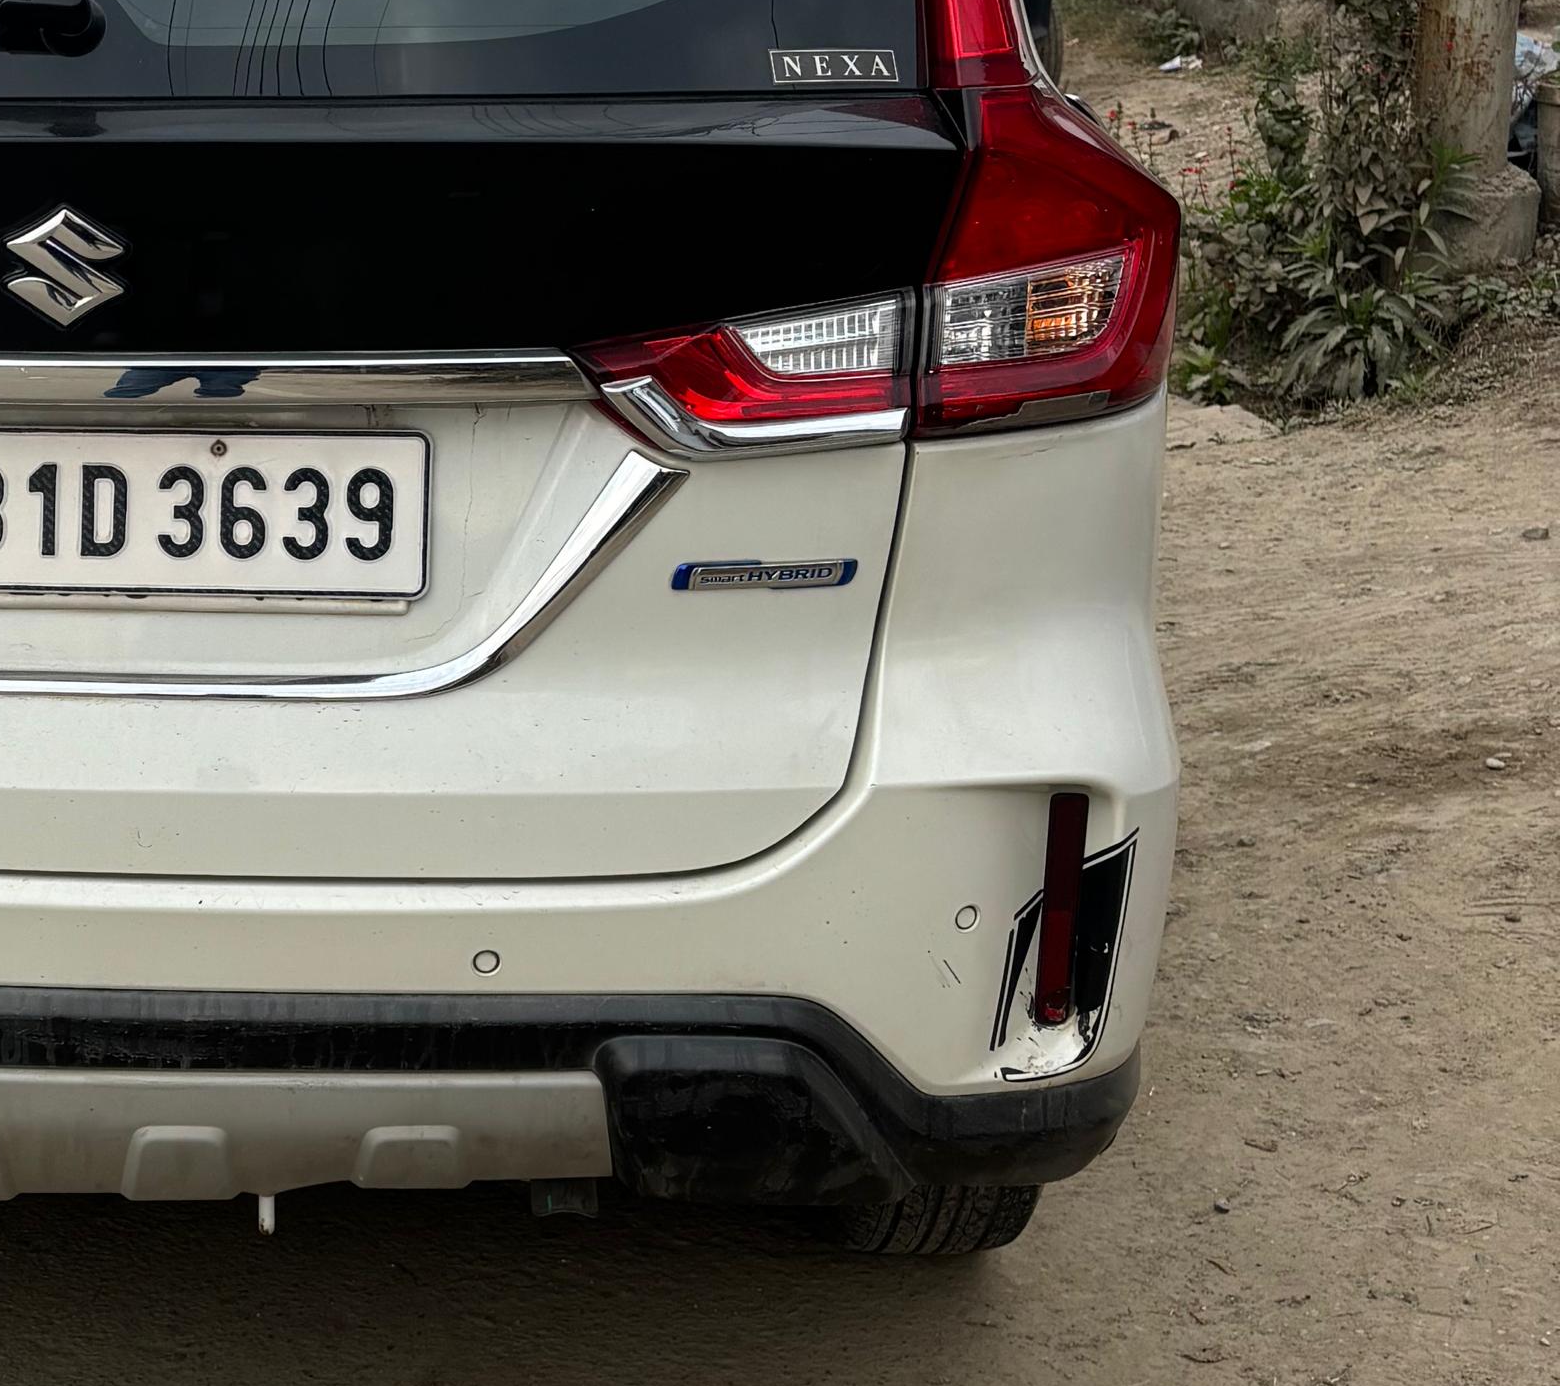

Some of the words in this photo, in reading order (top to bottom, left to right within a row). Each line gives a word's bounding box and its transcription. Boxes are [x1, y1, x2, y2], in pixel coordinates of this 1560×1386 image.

[782, 54, 891, 77] NEXA
[156, 464, 396, 561] 3639
[746, 566, 833, 583] HYBRID
